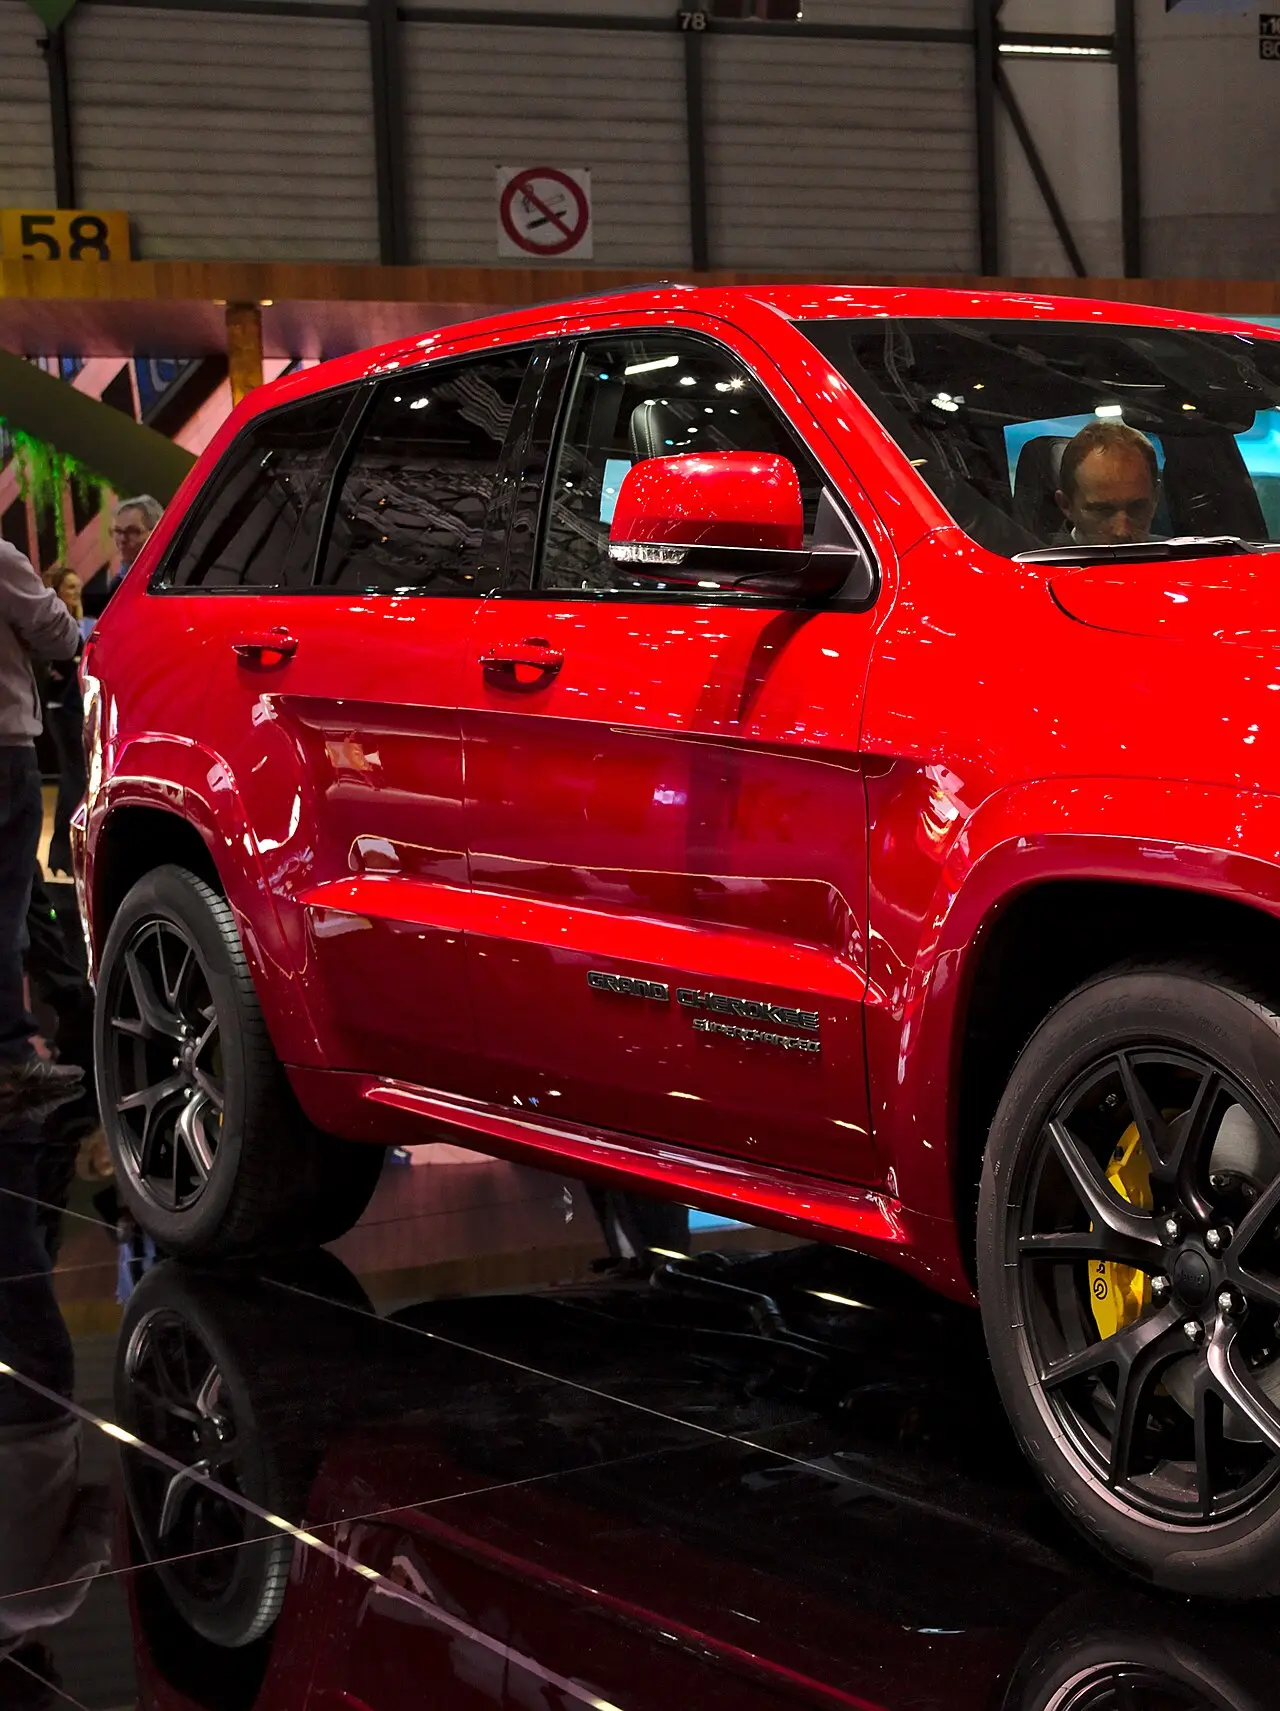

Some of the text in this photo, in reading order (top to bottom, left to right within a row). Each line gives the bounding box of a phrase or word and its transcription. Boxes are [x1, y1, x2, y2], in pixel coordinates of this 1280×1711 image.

[680, 12, 706, 30] 78
[21, 214, 110, 260] 58
[586, 970, 820, 1032] GRAND CHEROKEE
[692, 1018, 821, 1052] SUPERCHARGED
